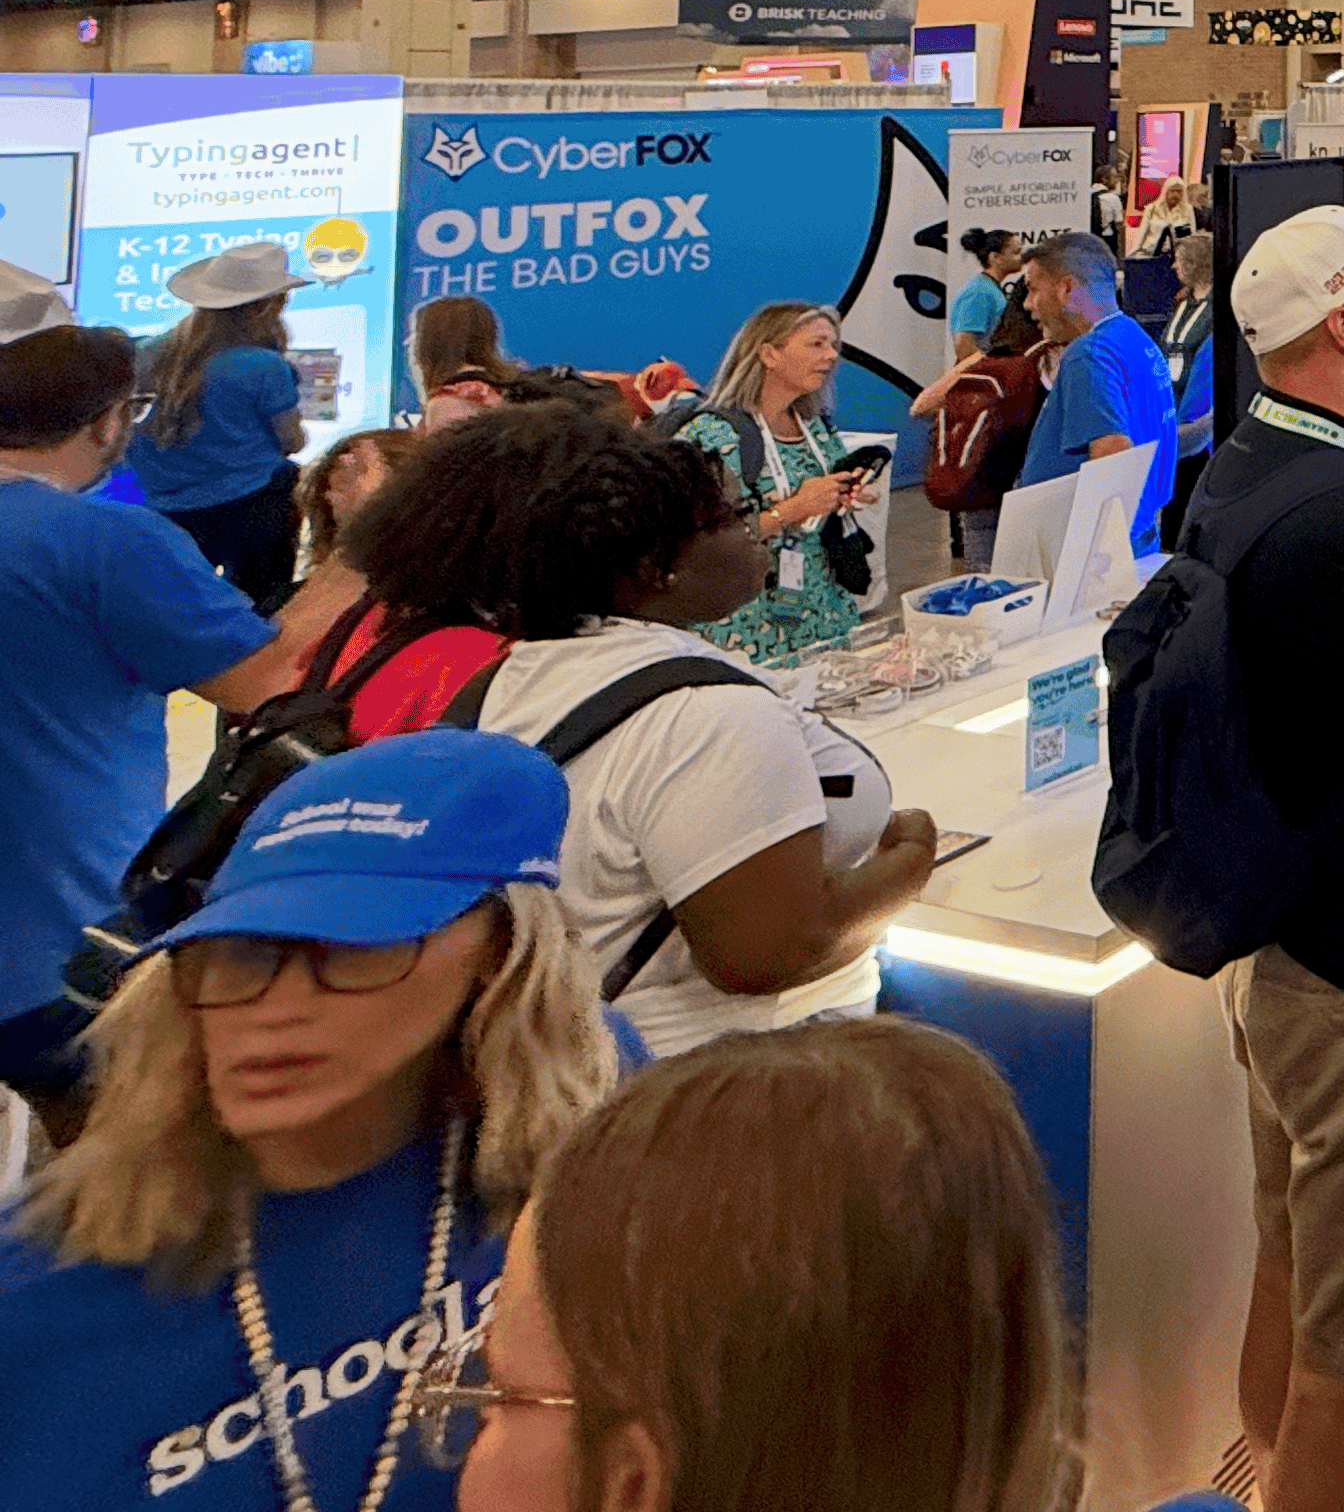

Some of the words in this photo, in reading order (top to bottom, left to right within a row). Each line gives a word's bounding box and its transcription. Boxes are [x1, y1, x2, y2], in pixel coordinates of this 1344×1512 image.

[757, 8, 805, 20] BRISK
[807, 8, 887, 21] TEACHING
[492, 133, 712, 180] CyberFOX
[178, 172, 217, 182] TYPE
[236, 170, 274, 180] TECH
[291, 168, 344, 177] THRIVE
[153, 186, 342, 209] typingagent.com
[964, 190, 1079, 209] CYBERSECURITY
[416, 193, 711, 258] OUTFOX
[118, 235, 191, 258] K-12
[116, 265, 138, 285] &
[413, 261, 498, 297] THE
[512, 253, 599, 289] BAD
[609, 243, 711, 279] GUYS
